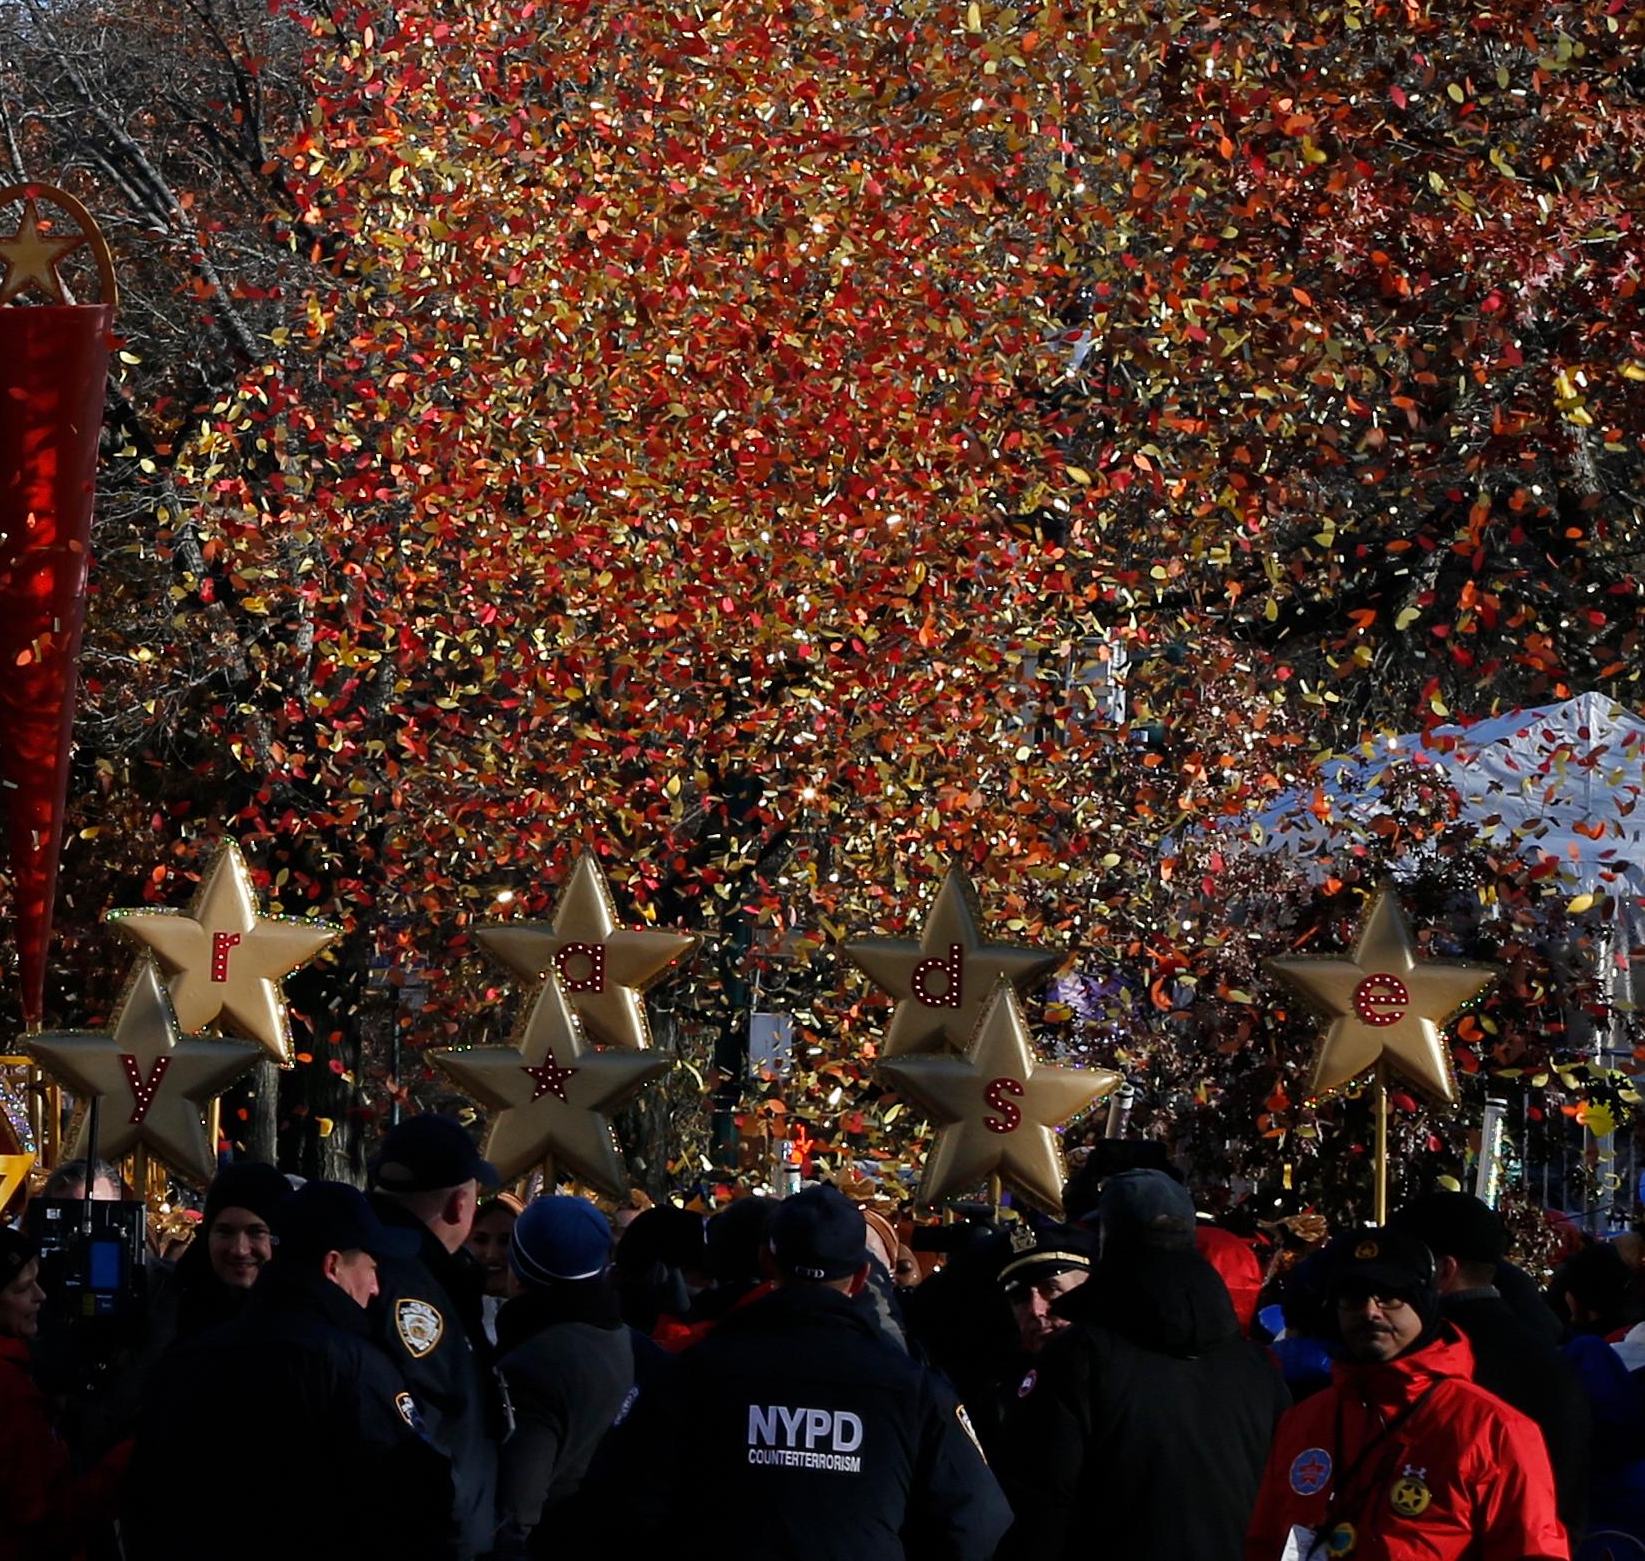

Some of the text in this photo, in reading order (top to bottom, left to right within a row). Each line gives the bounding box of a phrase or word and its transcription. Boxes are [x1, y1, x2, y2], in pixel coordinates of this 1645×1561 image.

[211, 932, 241, 983] r
[554, 942, 605, 992] a
[912, 944, 961, 1008] d
[1354, 973, 1410, 1027] e
[119, 1054, 171, 1124] y
[983, 1078, 1024, 1133] s
[747, 1404, 864, 1453] NYPD
[747, 1448, 862, 1473] COUNTERTERRORISM
